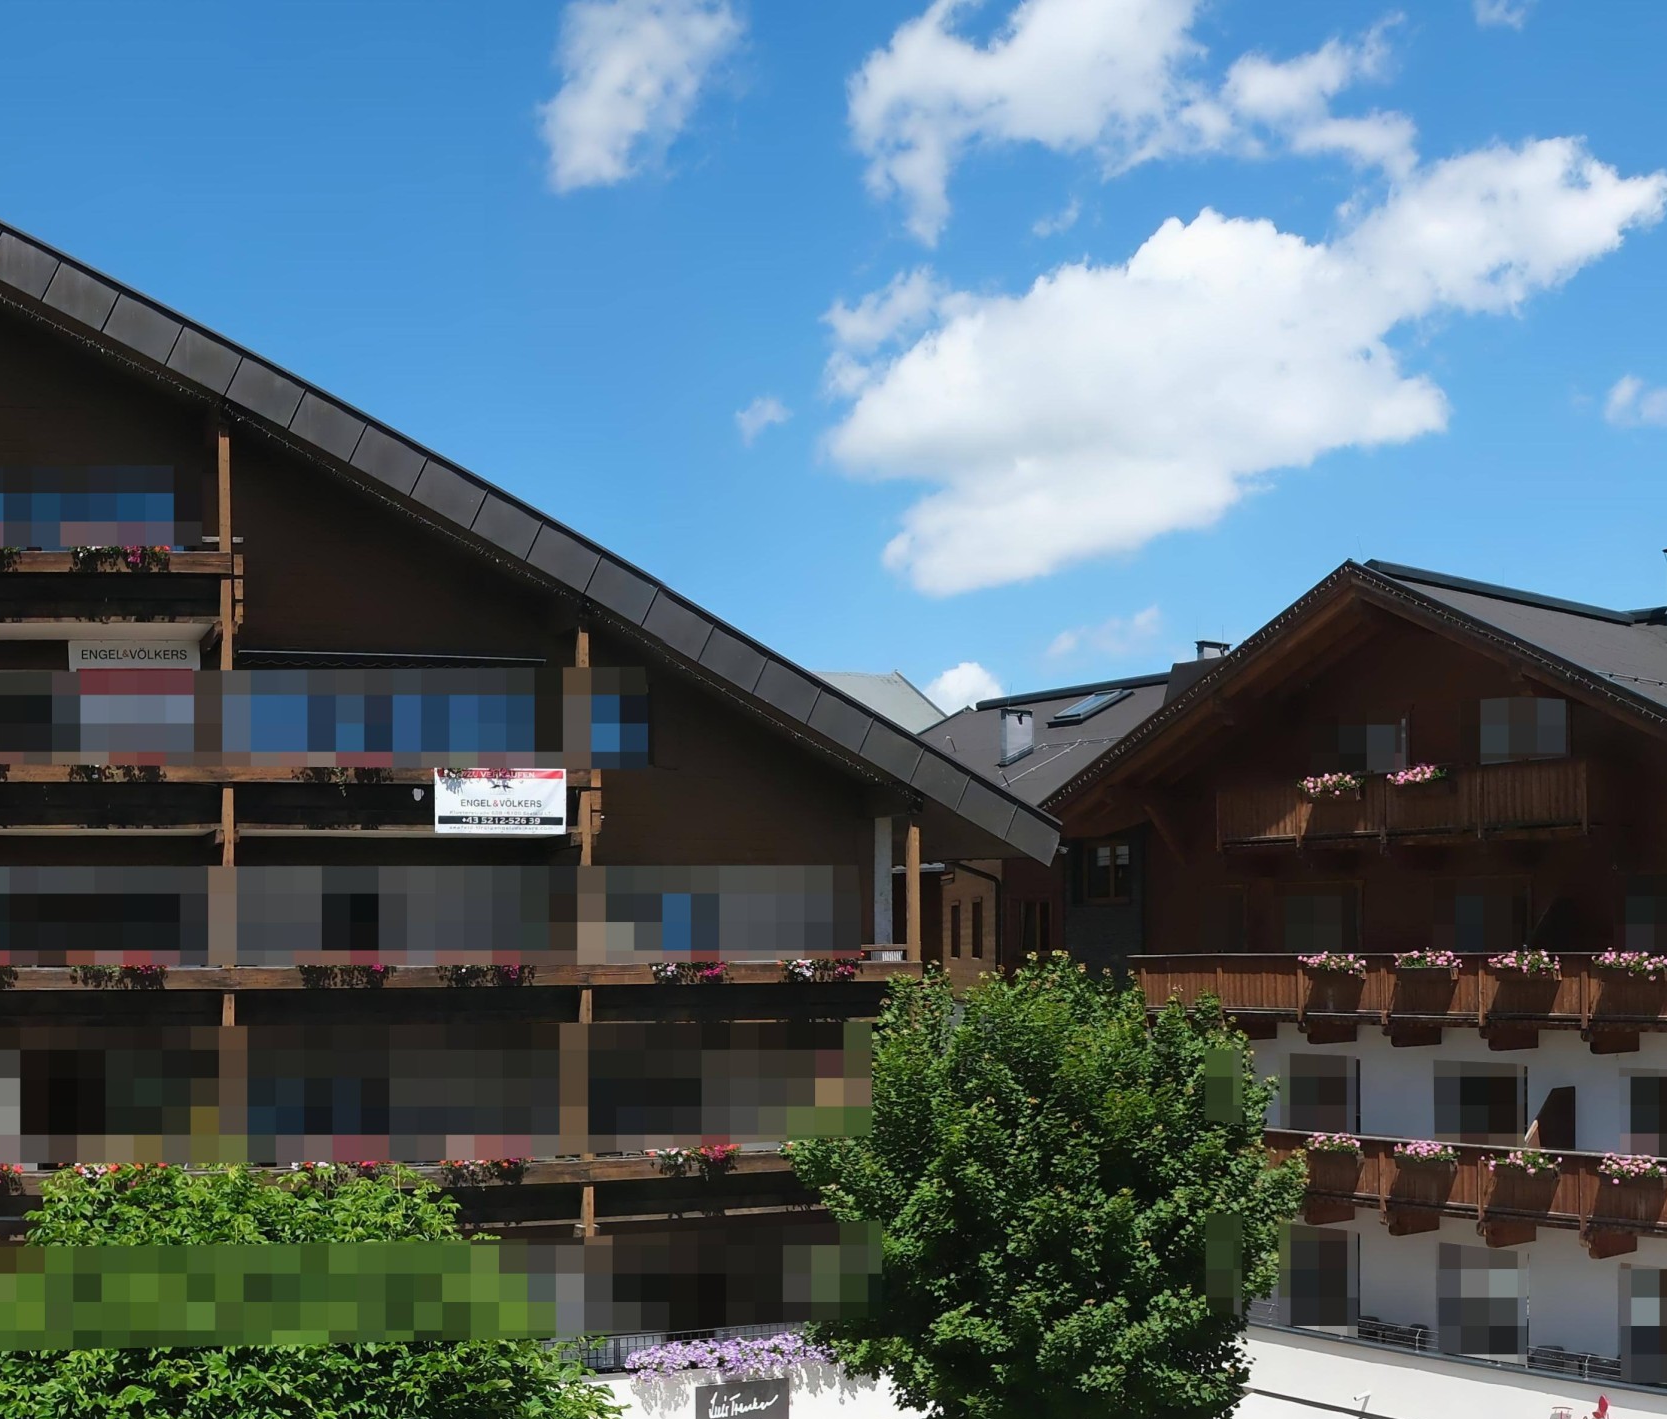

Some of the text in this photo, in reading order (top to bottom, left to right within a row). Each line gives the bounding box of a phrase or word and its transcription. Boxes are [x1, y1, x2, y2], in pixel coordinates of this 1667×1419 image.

[462, 816, 541, 825] +43 5212-526 39
